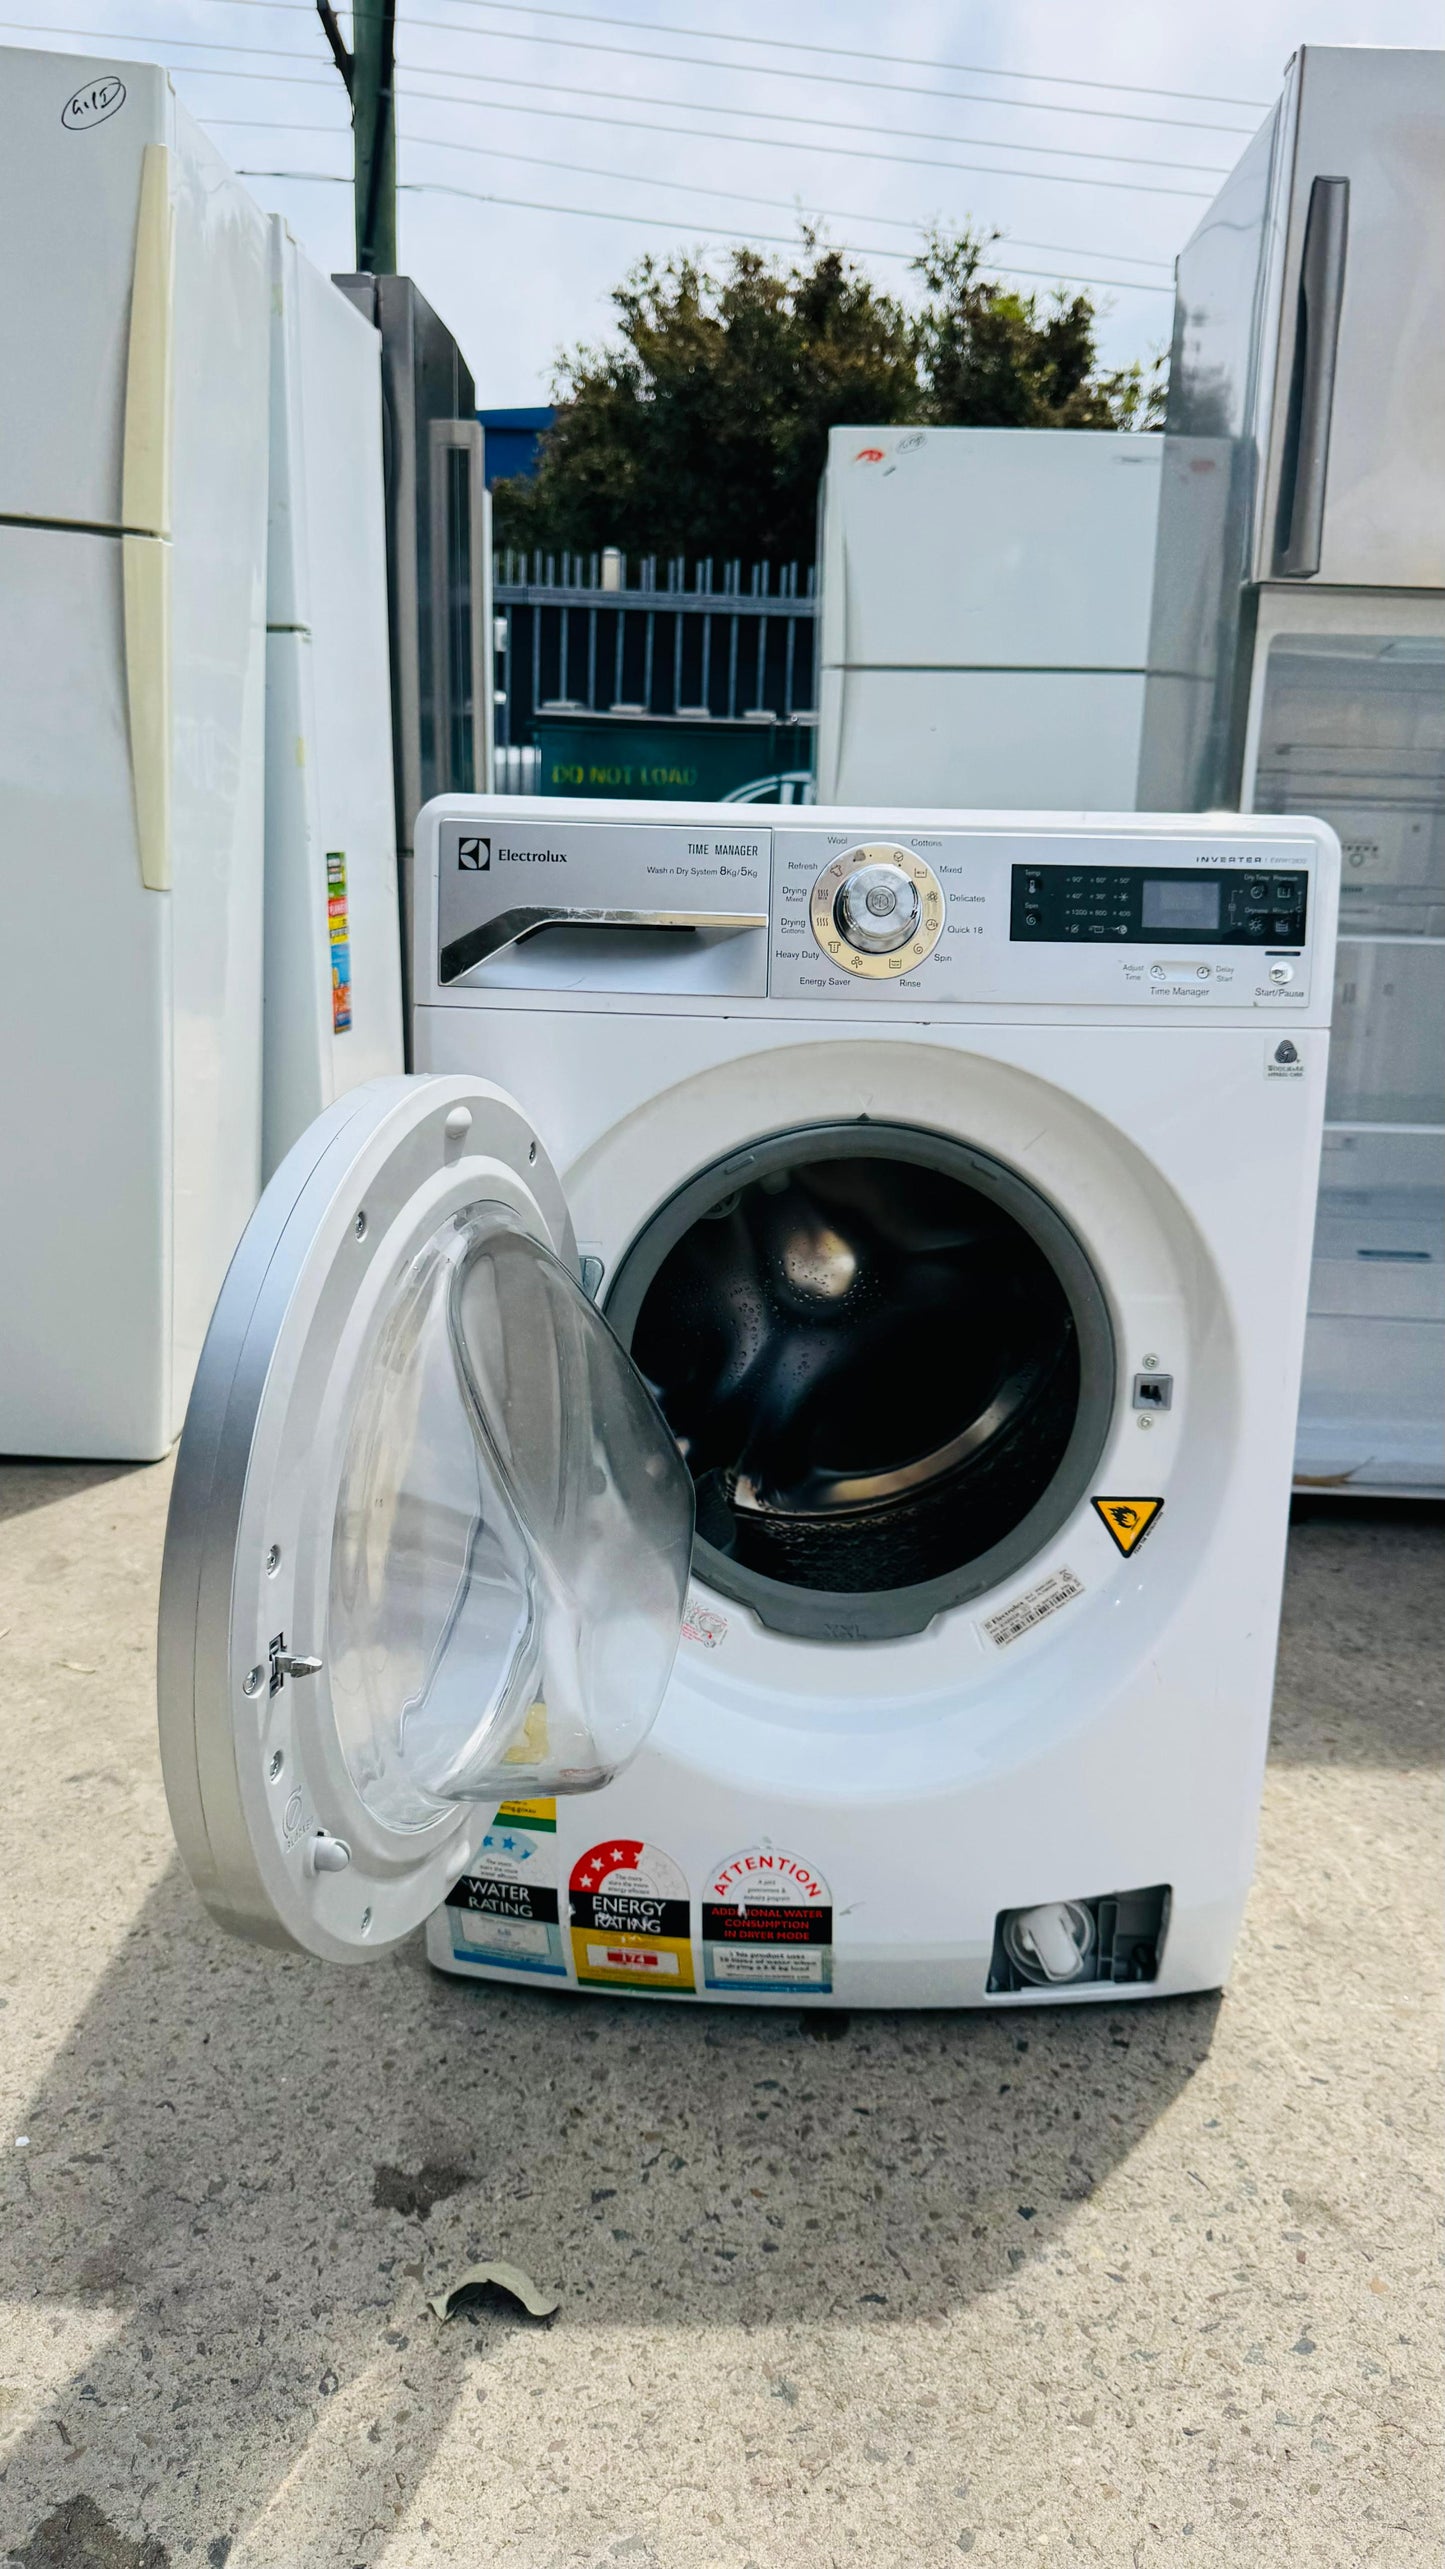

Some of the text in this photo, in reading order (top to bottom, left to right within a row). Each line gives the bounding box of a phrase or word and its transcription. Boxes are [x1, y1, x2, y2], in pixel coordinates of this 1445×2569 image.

[551, 766, 584, 784] DO
[590, 766, 632, 785] NOT
[828, 837, 848, 845] Wool
[911, 838, 943, 847] Cottons
[687, 843, 759, 856] TIME MANAGER
[498, 848, 568, 864] Electrolux
[1196, 856, 1262, 864] INVERTER
[787, 861, 819, 870] Refresh
[940, 865, 963, 874] Mixed
[647, 866, 668, 875] Wash
[676, 867, 689, 877] Dry
[690, 867, 718, 877] System
[782, 886, 808, 897] Drying
[949, 893, 986, 903] Delicates
[780, 917, 806, 928] Drying
[780, 927, 805, 935] Cottons
[947, 925, 984, 935] Quick 18
[775, 950, 820, 961] Heavy Duty
[934, 953, 953, 963] Spin
[1122, 964, 1145, 972] Adjust
[1216, 965, 1234, 974] Delay
[799, 976, 851, 987] Energy Saver
[1125, 973, 1141, 981] Time
[1216, 975, 1233, 983] Start
[899, 979, 921, 988] Rinse
[1150, 986, 1210, 999] Time Manager
[1254, 987, 1305, 998] Start/Pause
[713, 1855, 823, 1898] ATTENTION
[468, 1878, 531, 1902] WATER
[468, 1896, 533, 1917] RATING
[592, 1896, 667, 1917] ENERGY
[783, 1909, 823, 1919] WATER
[594, 1913, 661, 1934] RATING
[724, 1918, 810, 1930] CONSUMPTION
[724, 1929, 810, 1941] IN DRYER MODE
